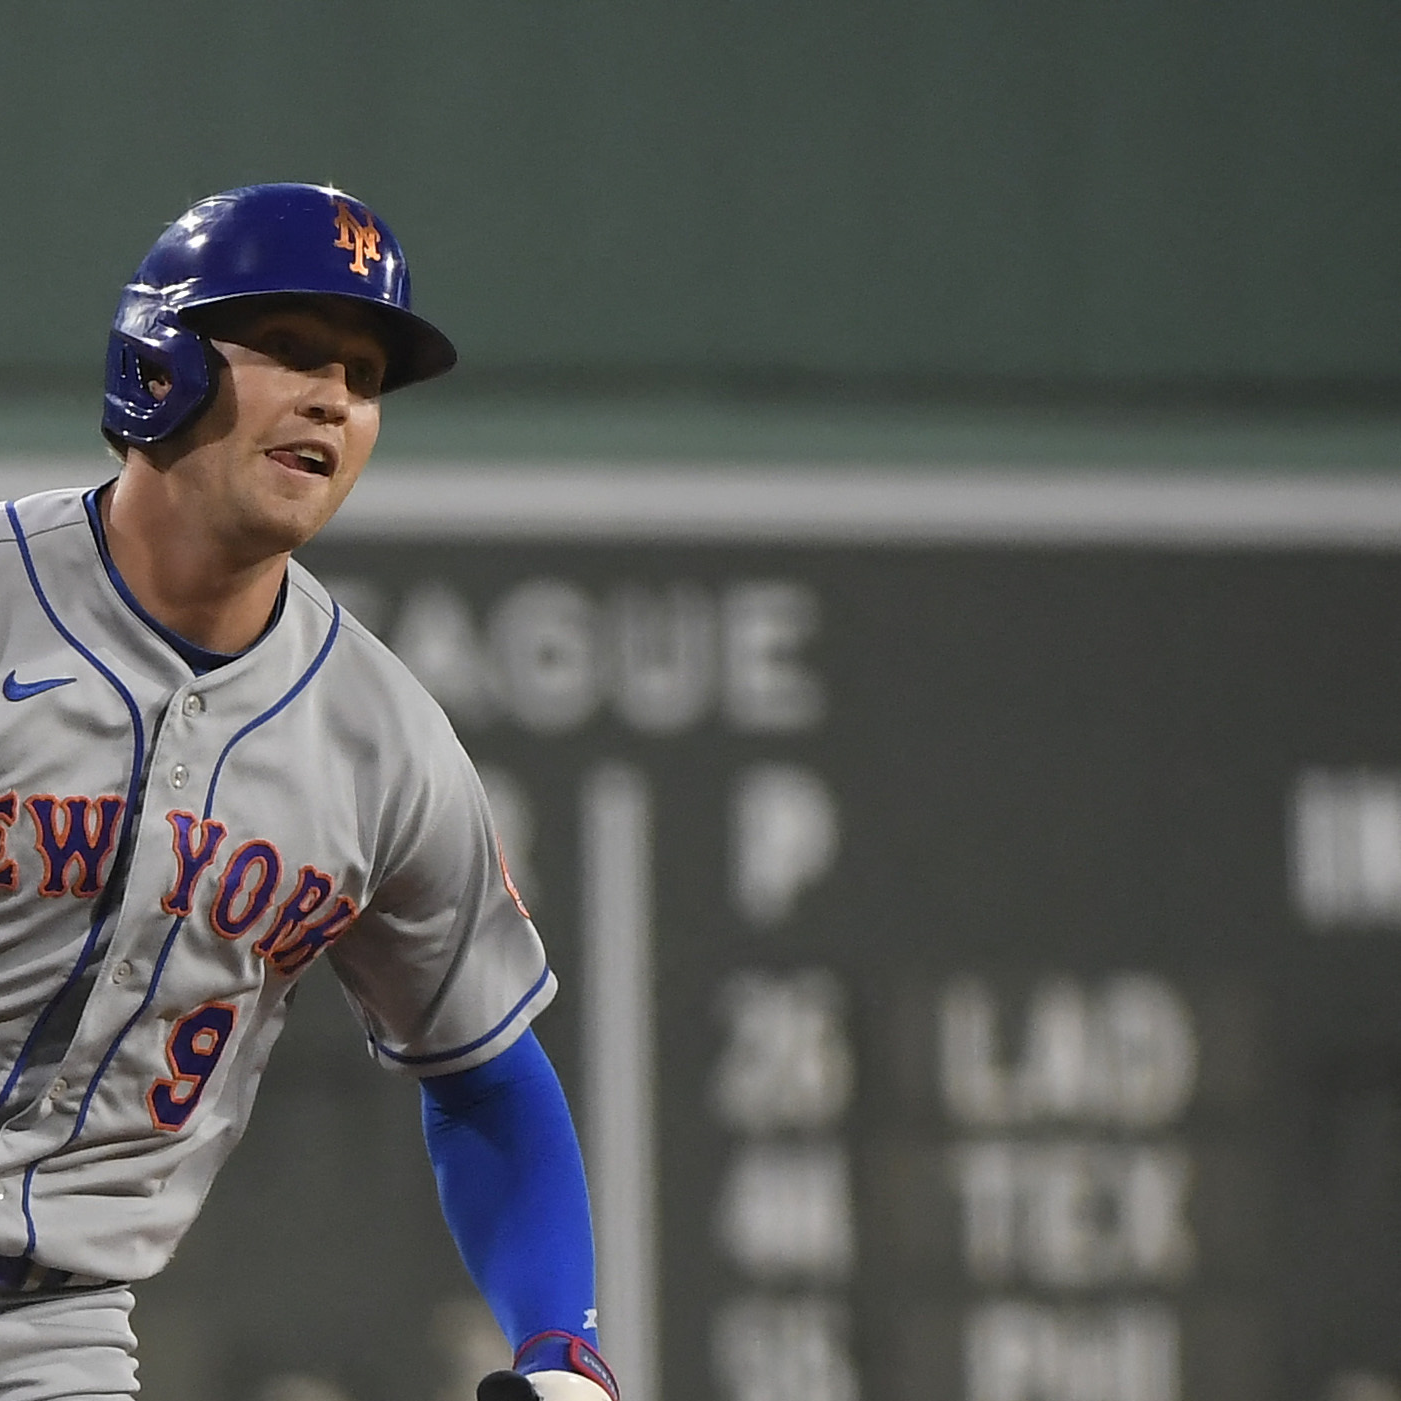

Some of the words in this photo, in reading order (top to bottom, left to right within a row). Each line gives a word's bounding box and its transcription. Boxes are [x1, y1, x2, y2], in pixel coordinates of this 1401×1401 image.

[160, 809, 359, 976] YORK
[734, 767, 838, 918] P
[145, 1000, 238, 1131] 9
[938, 975, 1196, 1128] LAD
[950, 1140, 1191, 1286] TEX
